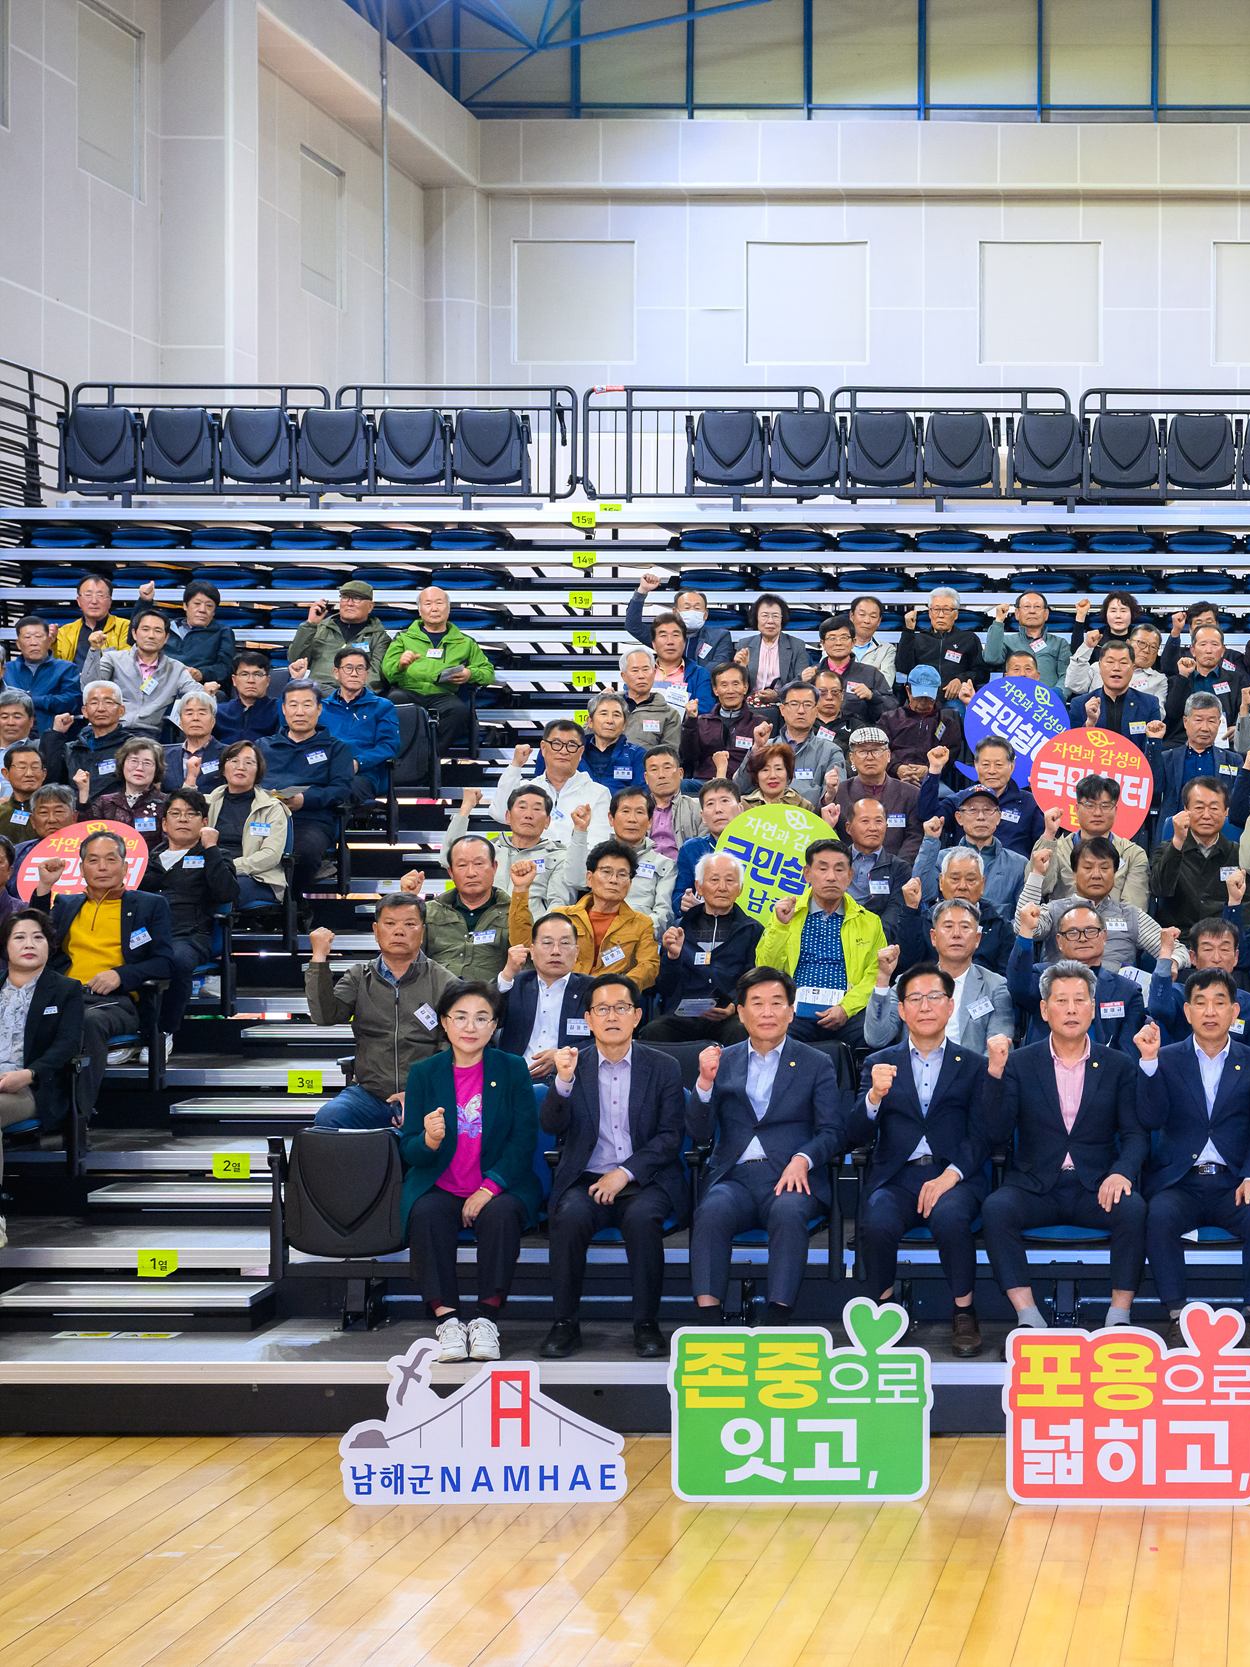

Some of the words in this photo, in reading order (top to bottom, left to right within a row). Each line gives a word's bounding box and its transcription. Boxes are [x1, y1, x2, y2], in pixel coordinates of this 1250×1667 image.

[575, 515, 593, 525] 15열
[576, 555, 594, 565] 14열
[572, 596, 590, 605] 13열
[575, 675, 593, 685] 11열
[999, 680, 1034, 713] 자연과
[1032, 705, 1067, 735] 감성의
[971, 690, 1051, 763] 국민쉼
[1052, 741, 1096, 763] 자연과
[1098, 747, 1142, 771] 감성의
[744, 815, 791, 846] 자연과
[297, 1077, 314, 1089] 3열
[223, 1160, 241, 1173] 2열
[150, 1257, 168, 1271] 1열
[681, 1342, 920, 1410] 존중으로
[719, 1417, 879, 1489] 잇고,
[1020, 1418, 1250, 1492] 넓히고,
